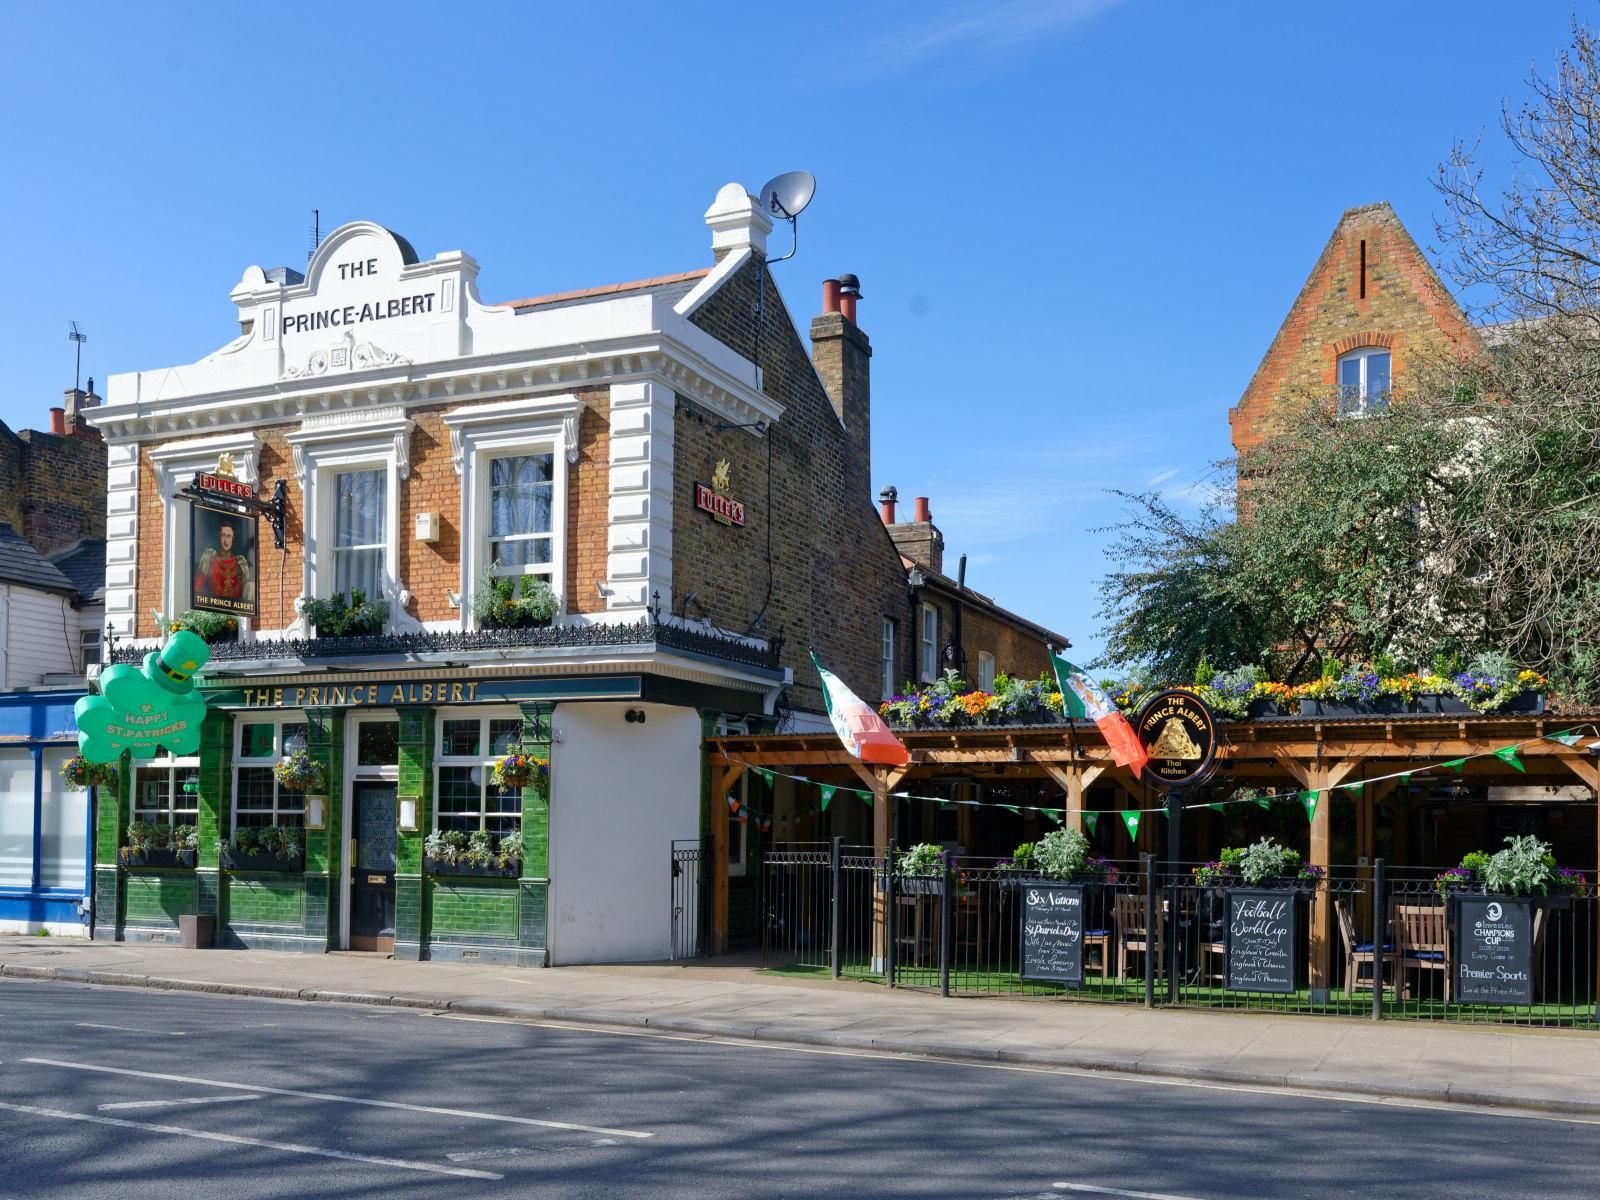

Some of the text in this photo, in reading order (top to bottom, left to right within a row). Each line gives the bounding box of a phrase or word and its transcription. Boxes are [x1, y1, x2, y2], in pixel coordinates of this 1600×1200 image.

[338, 258, 378, 280] THE
[196, 595, 254, 611] THE PRINCE ALBERT
[243, 681, 479, 707] THE PRINCE ALBERT
[1167, 697, 1184, 706] THE
[125, 709, 168, 725] HAPPY
[1143, 706, 1207, 731] PRINCE ALBERT
[1026, 889, 1080, 907] Six Nations
[1233, 899, 1287, 921] Football
[1230, 920, 1287, 943] World Cup
[1482, 920, 1514, 930] Investec
[1064, 926, 1080, 942] Day
[1473, 929, 1515, 938] CHAMPIONS
[1485, 936, 1502, 945] CUP
[1025, 937, 1074, 949] With Live Music
[1231, 945, 1258, 959] England
[1471, 951, 1488, 961] Every
[1490, 951, 1506, 960] Game
[1025, 954, 1046, 965] Irish
[1230, 957, 1257, 970] England
[1262, 958, 1287, 969] Ghana
[1230, 972, 1257, 985] England
[1460, 963, 1528, 983] Premier Sports
[1463, 985, 1473, 993] Live
[1480, 986, 1490, 994] the
[1490, 986, 1508, 995] Prince
[1508, 987, 1527, 996] Albert
